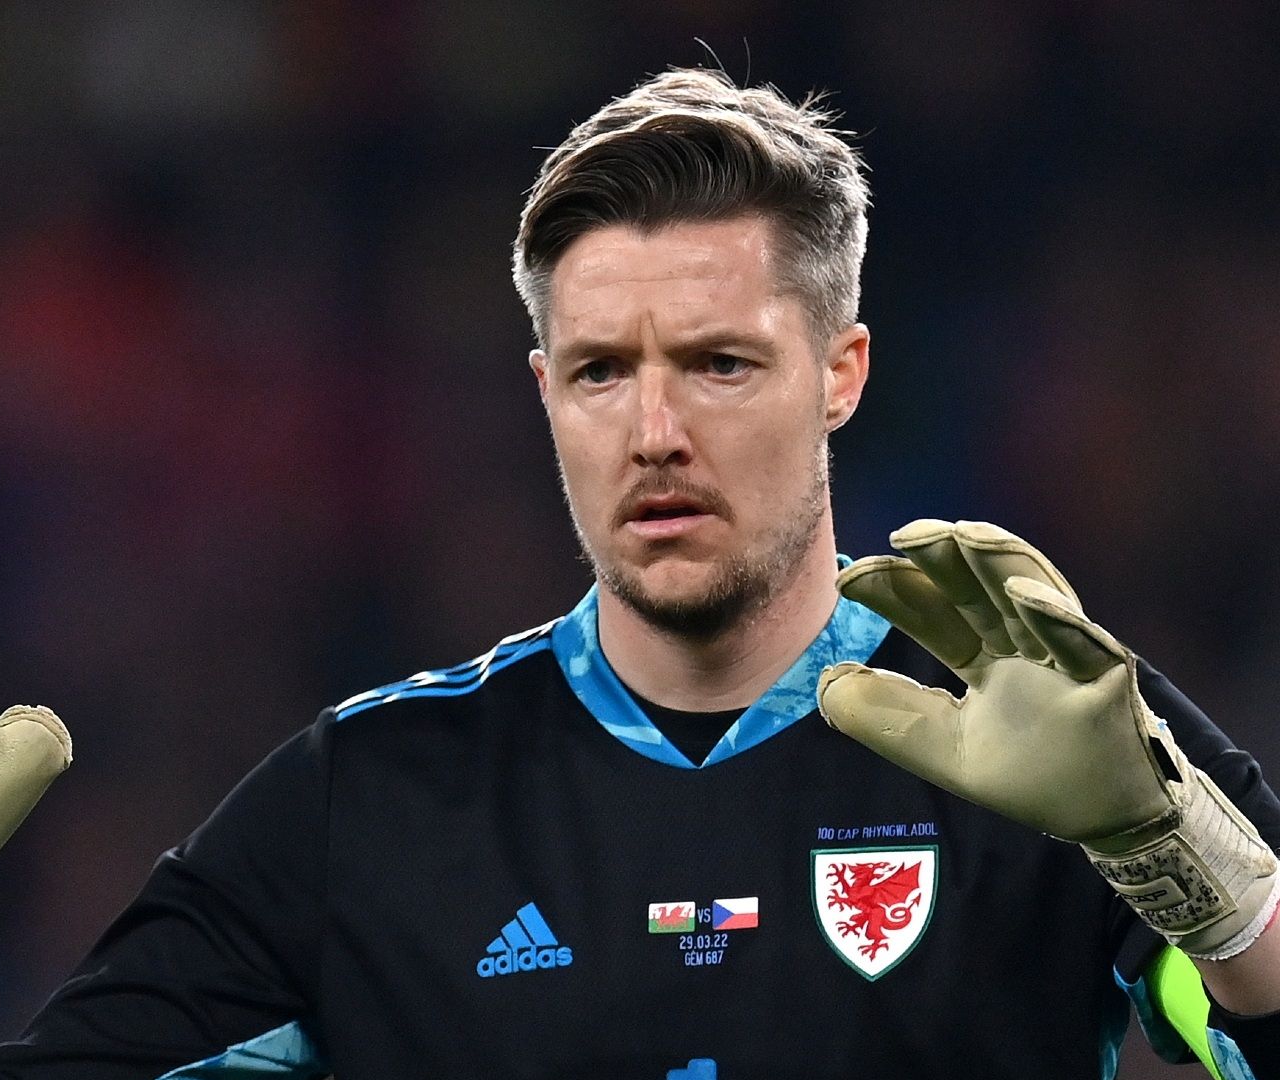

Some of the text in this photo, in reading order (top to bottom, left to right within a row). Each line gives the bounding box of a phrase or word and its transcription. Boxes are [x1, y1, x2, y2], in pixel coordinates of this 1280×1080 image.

[818, 822, 938, 840] 100 CAP RHYNGWLADOL
[697, 908, 711, 923] VS
[679, 933, 728, 950] 29.03.22
[476, 945, 573, 978] adidas
[705, 950, 724, 965] 687
